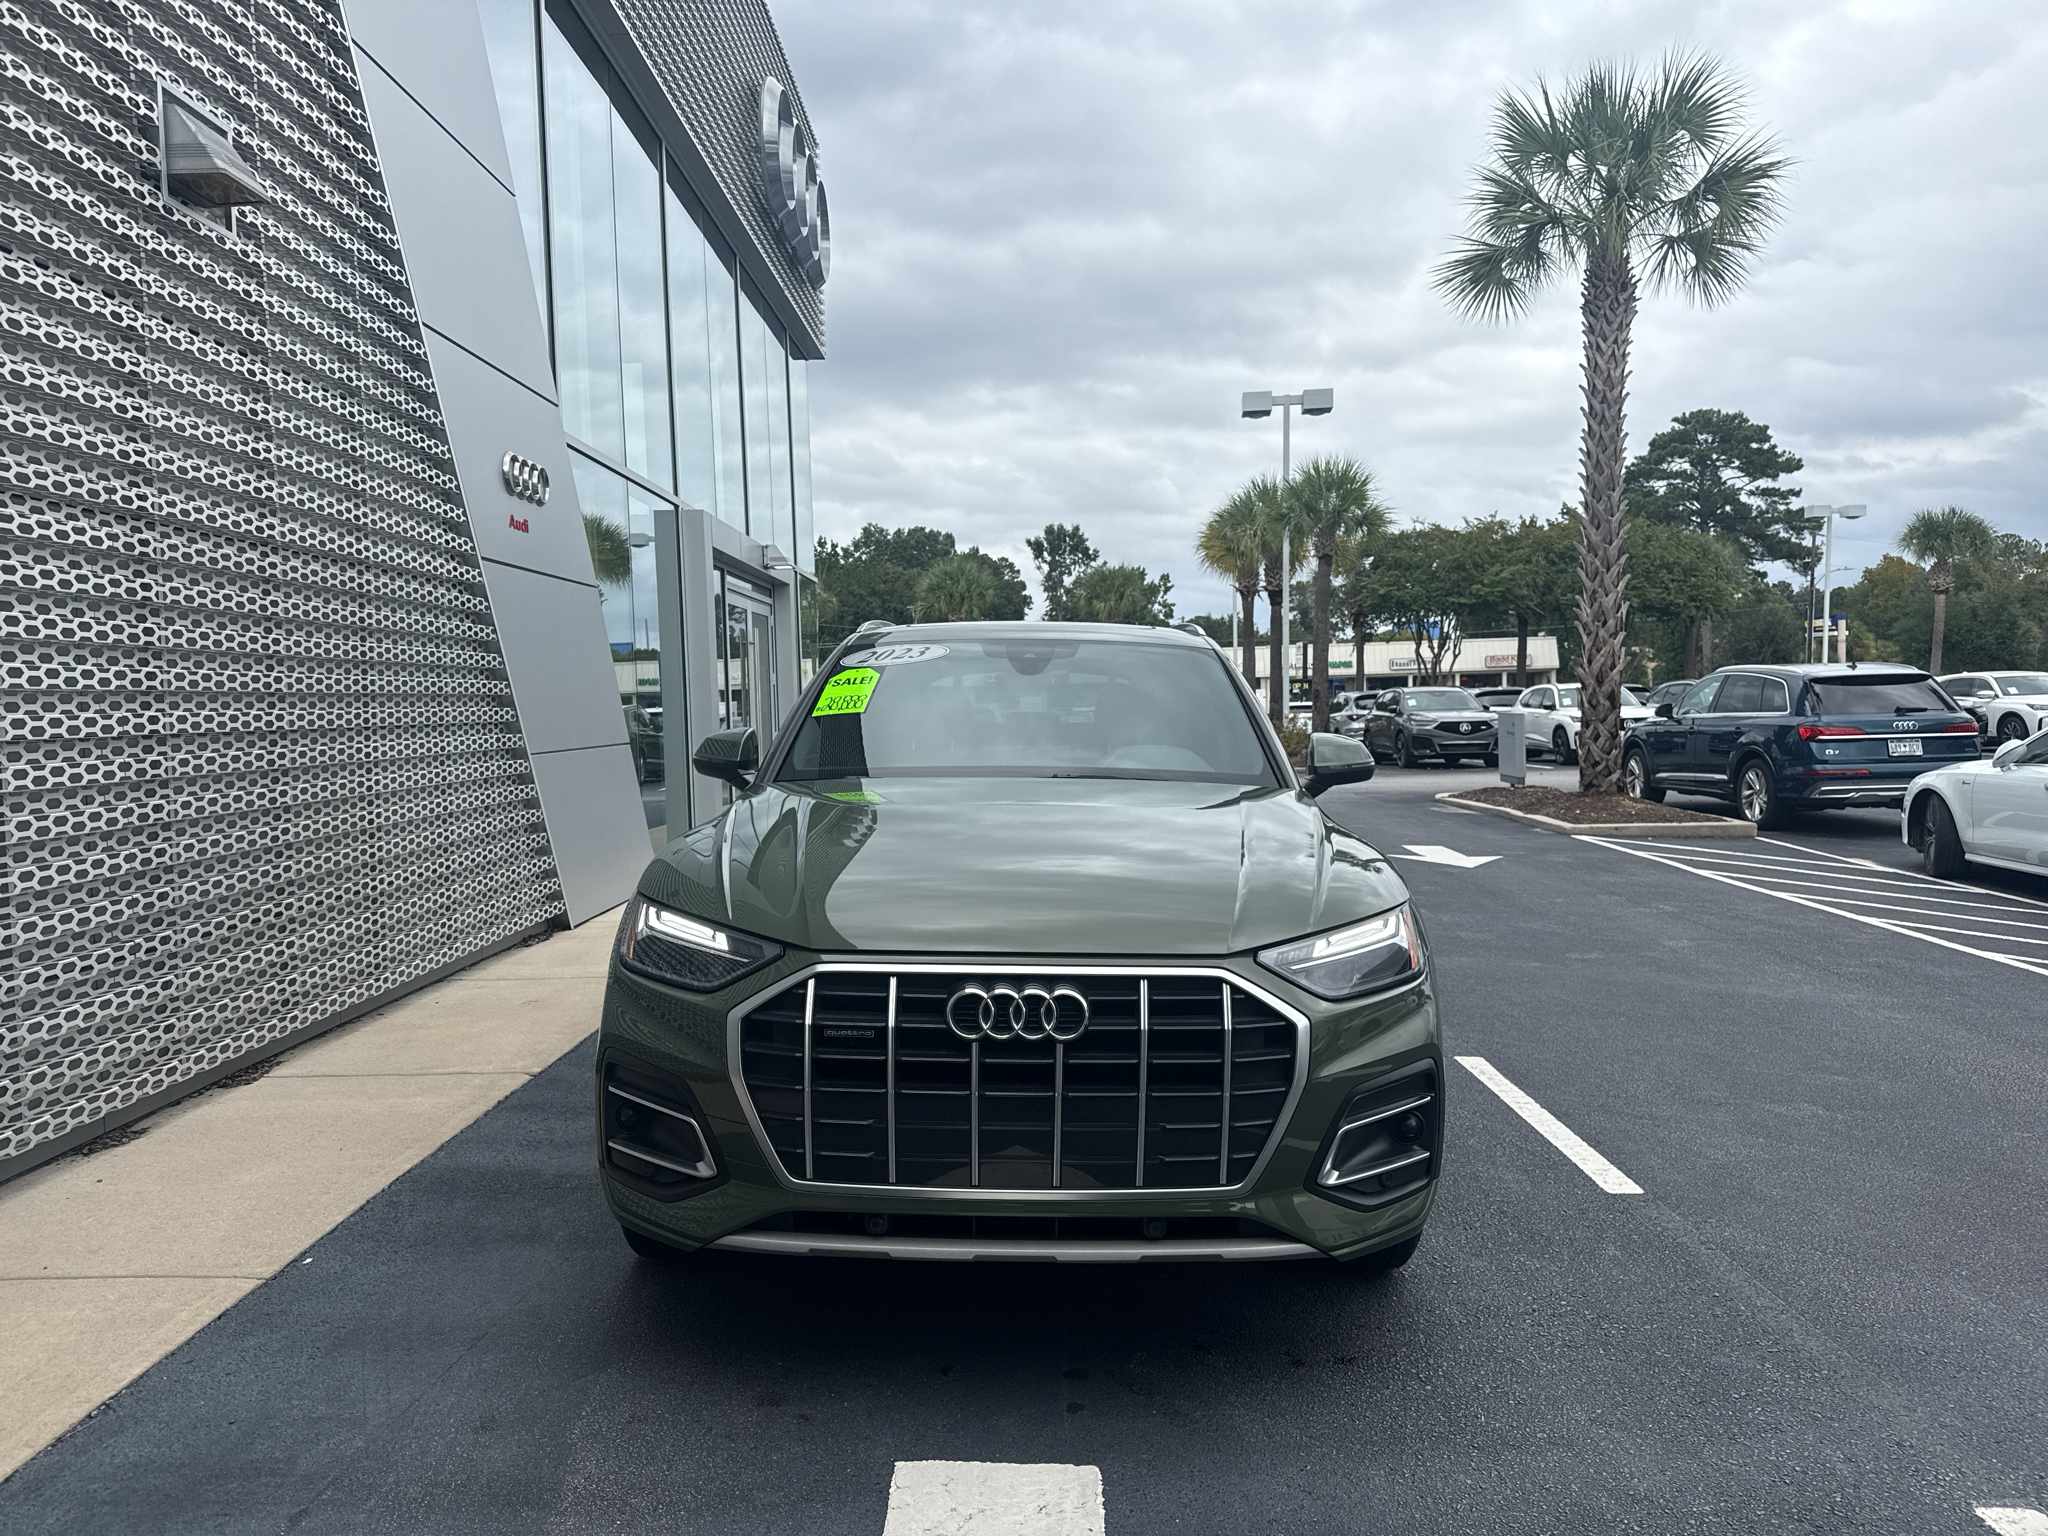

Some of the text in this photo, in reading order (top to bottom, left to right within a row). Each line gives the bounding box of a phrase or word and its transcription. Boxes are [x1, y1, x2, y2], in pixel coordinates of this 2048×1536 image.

[509, 514, 529, 533] Audi
[854, 647, 930, 664] 2023
[1292, 682, 1309, 690] OPN
